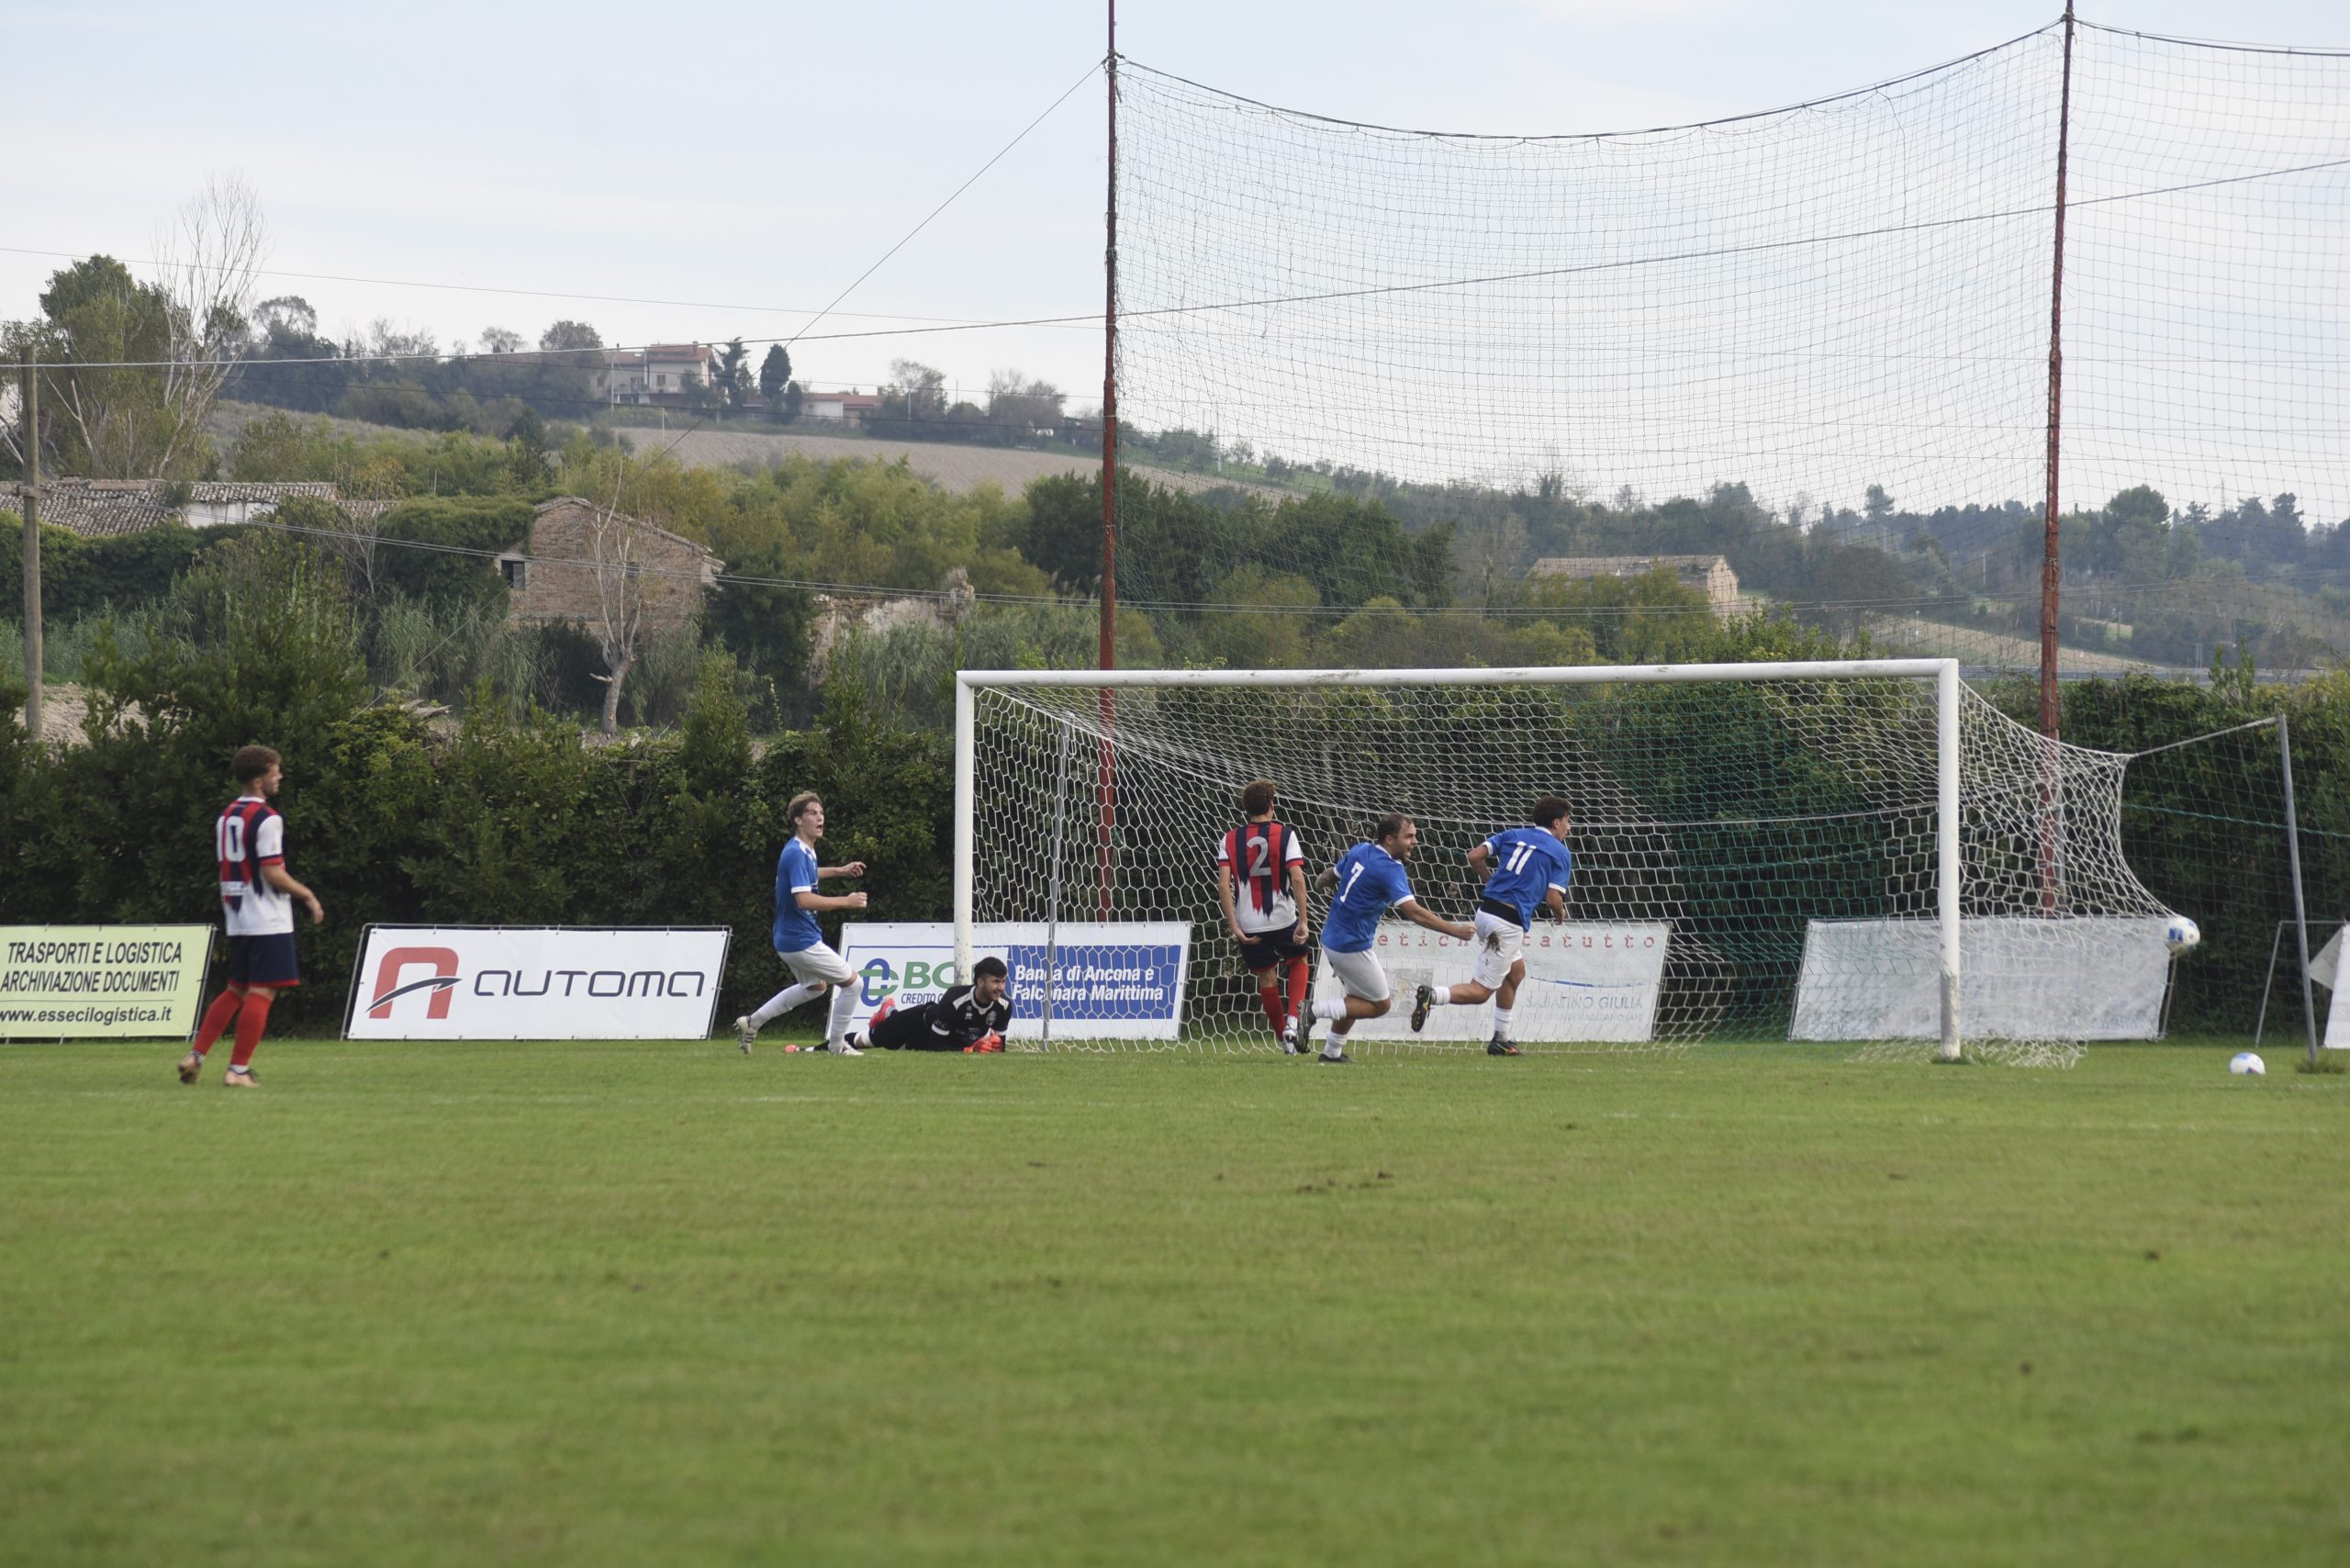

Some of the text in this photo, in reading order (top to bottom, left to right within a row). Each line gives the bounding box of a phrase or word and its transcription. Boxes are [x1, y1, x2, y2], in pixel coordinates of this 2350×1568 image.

[216, 814, 247, 863] 10
[1246, 835, 1272, 878] 2
[1505, 841, 1538, 876] 11
[1339, 860, 1365, 902] 7
[8, 942, 182, 964] TRASPORTI E LOGISTICA
[0, 969, 180, 992] ARCHIVIAZIONE DOCUMENTI
[902, 960, 976, 990] BC
[1066, 965, 1081, 981] di
[1084, 965, 1141, 981] Ancona
[1145, 969, 1155, 981] e
[901, 992, 936, 1004] CREDITO
[1090, 984, 1164, 1001] Marittima
[1598, 996, 1643, 1009] GIULIA
[0, 1006, 172, 1026] www.essecilogistica.it
